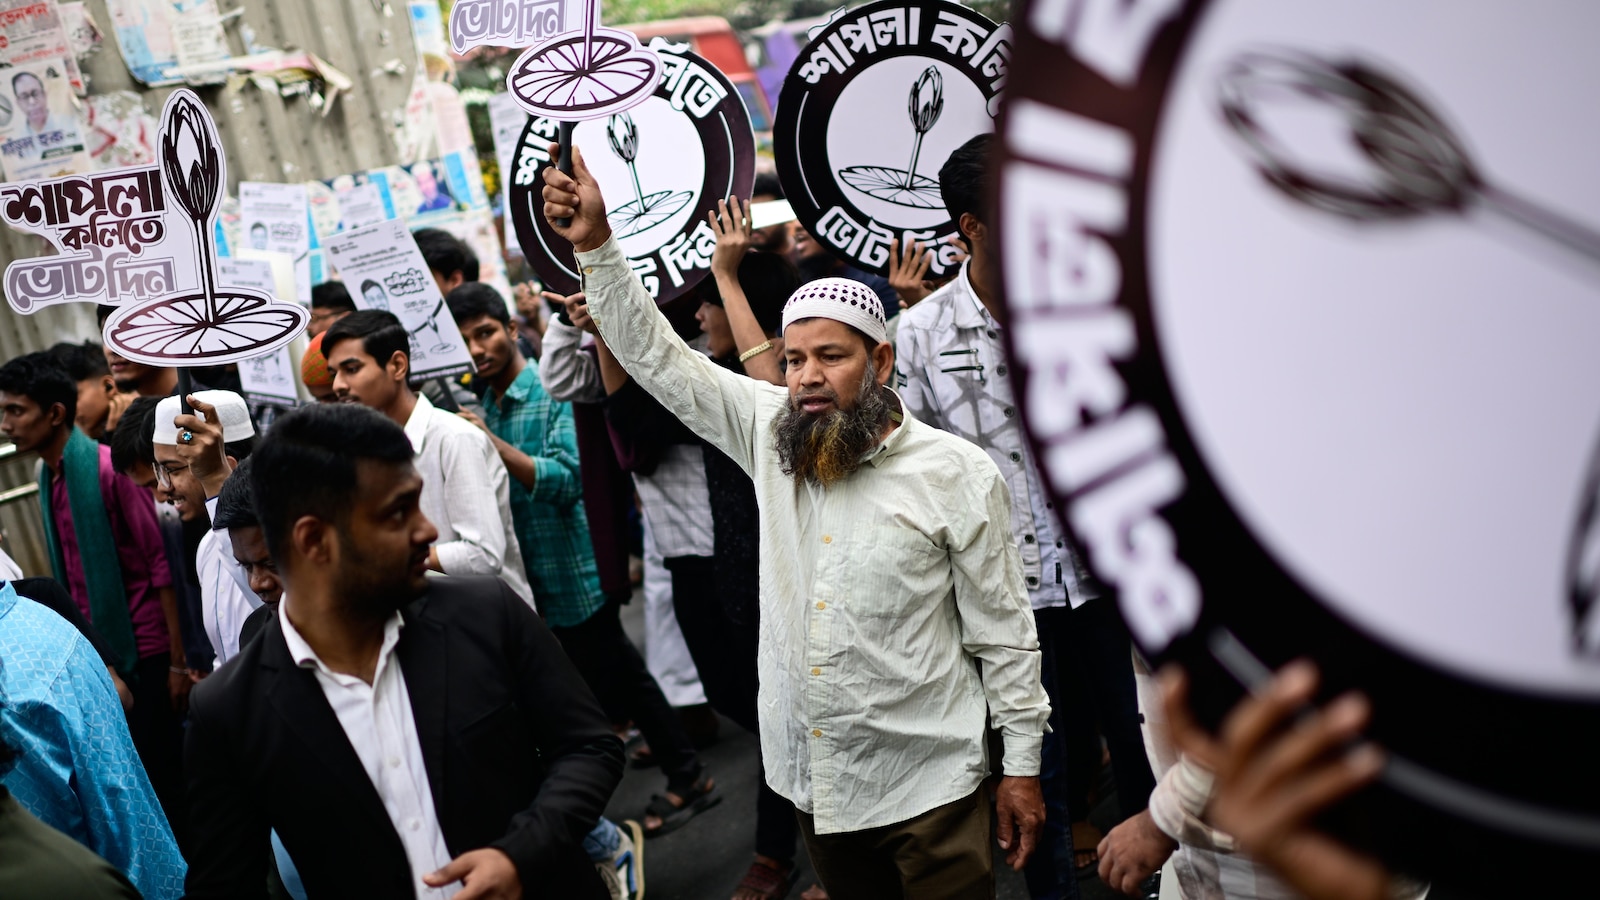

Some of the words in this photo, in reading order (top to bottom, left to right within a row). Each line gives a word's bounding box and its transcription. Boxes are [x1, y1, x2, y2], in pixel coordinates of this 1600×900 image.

[798, 7, 922, 84] শাপলা
[1, 169, 165, 226] শাপলা
[58, 211, 164, 254] কলিতে
[9, 245, 105, 309] ভোট
[105, 252, 175, 300] দিন
